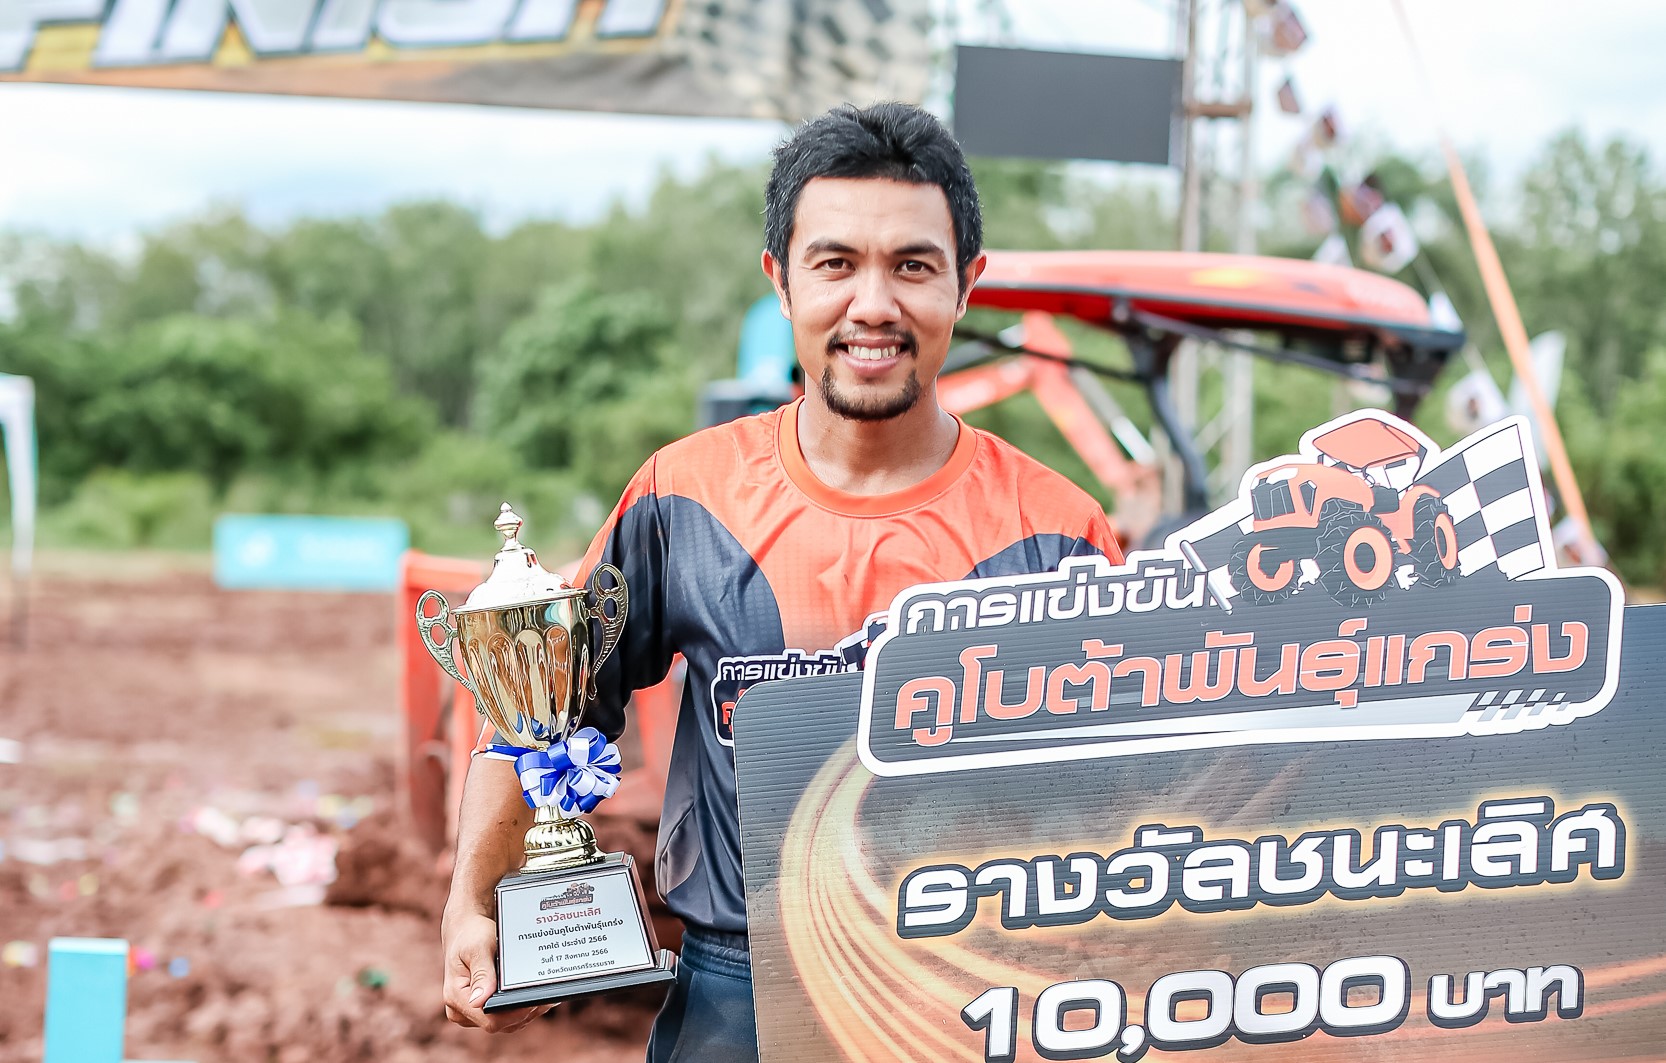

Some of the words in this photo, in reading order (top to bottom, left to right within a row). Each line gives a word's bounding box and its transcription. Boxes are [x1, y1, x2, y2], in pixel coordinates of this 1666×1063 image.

[904, 564, 1206, 635] การแข่งขัน
[893, 604, 1590, 747] คูโบต้าพันธุ์แกร่ง
[898, 797, 1626, 938] รางวัลชนะเลิศ
[518, 918, 624, 941] การแข่งขันคูโบต้าพันธุ์แกร่ง
[536, 907, 601, 924] รางวัลชนะเลิศ
[588, 934, 608, 944] 2566
[591, 948, 609, 957] 2566
[961, 955, 1411, 1063] 10,000
[1430, 965, 1584, 1022] บาท
